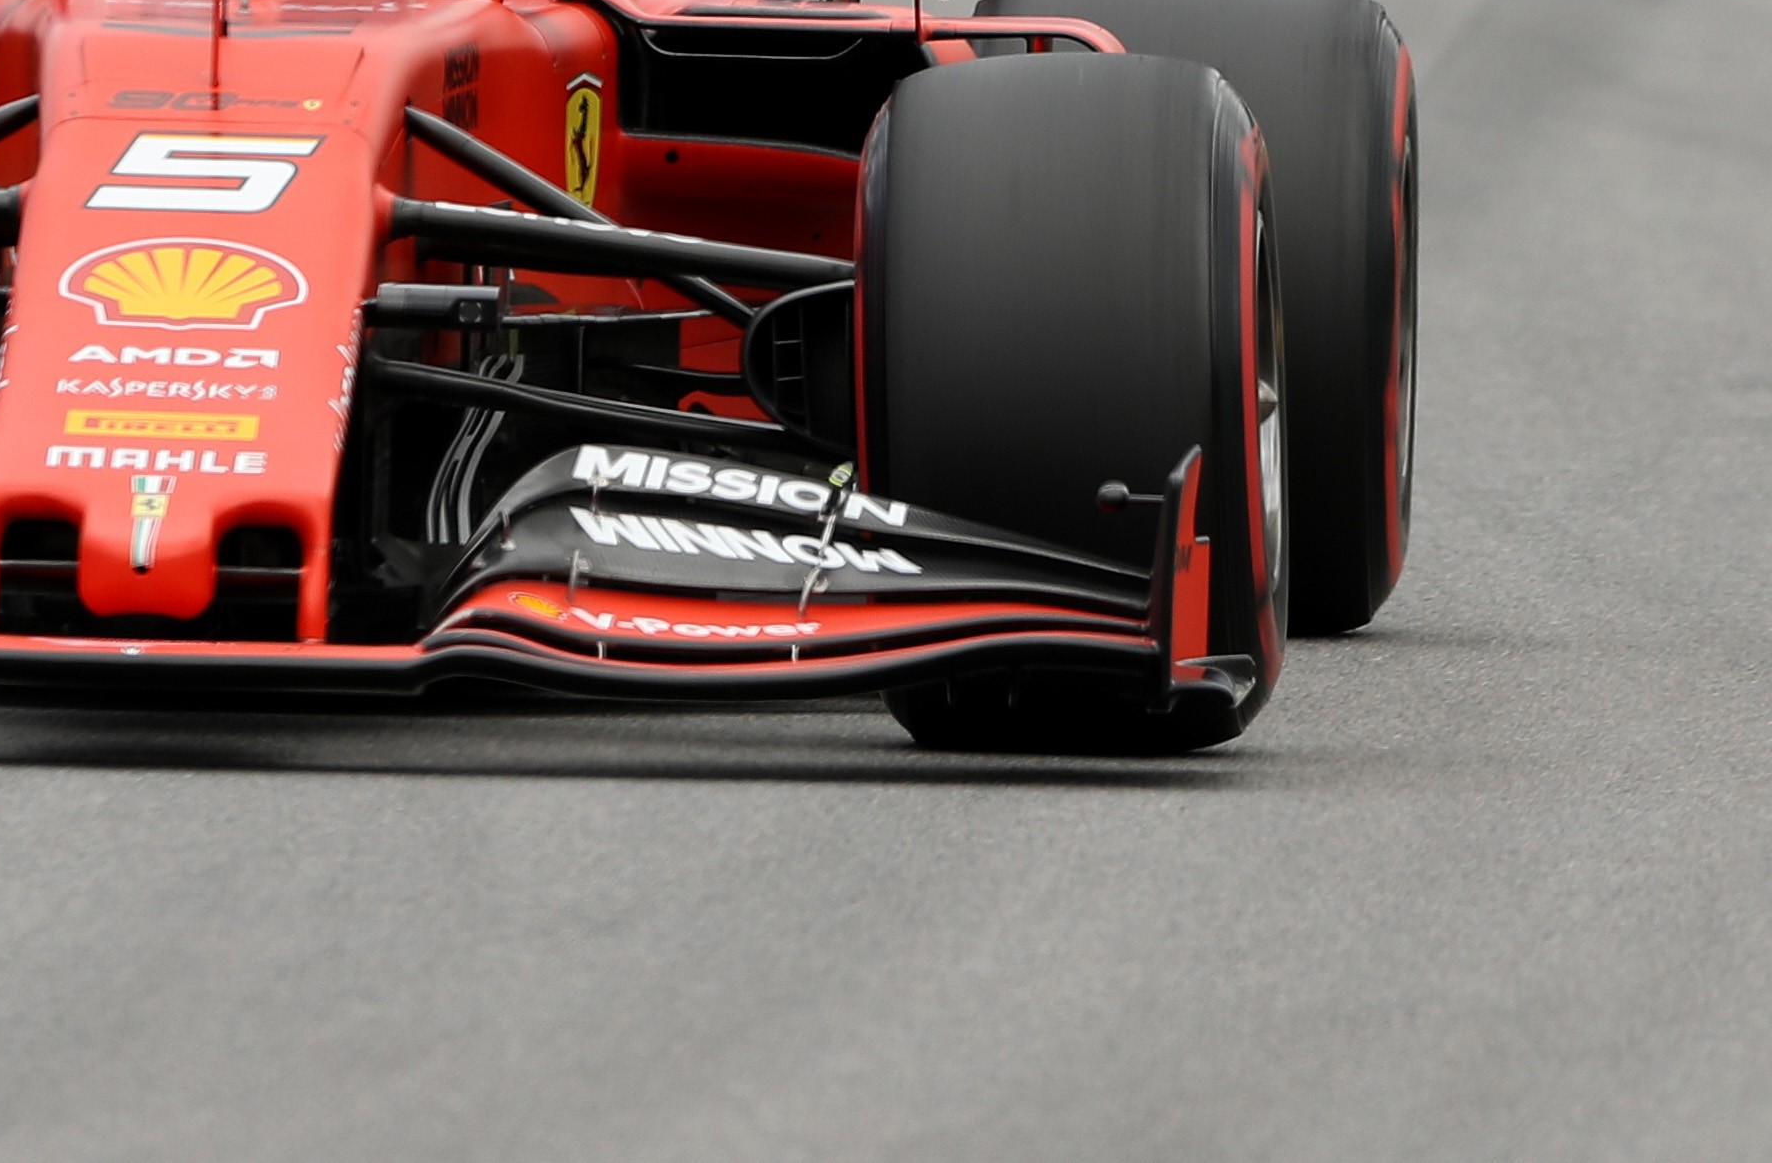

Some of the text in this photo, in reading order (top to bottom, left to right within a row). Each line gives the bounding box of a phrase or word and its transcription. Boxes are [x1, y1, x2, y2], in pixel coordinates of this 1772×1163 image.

[82, 130, 326, 213] 5
[56, 376, 256, 402] KASPERSKY
[45, 445, 269, 475] MAHLE
[572, 444, 911, 527] MISSION
[569, 506, 923, 575] WINNOW
[569, 606, 822, 637] V-Power
